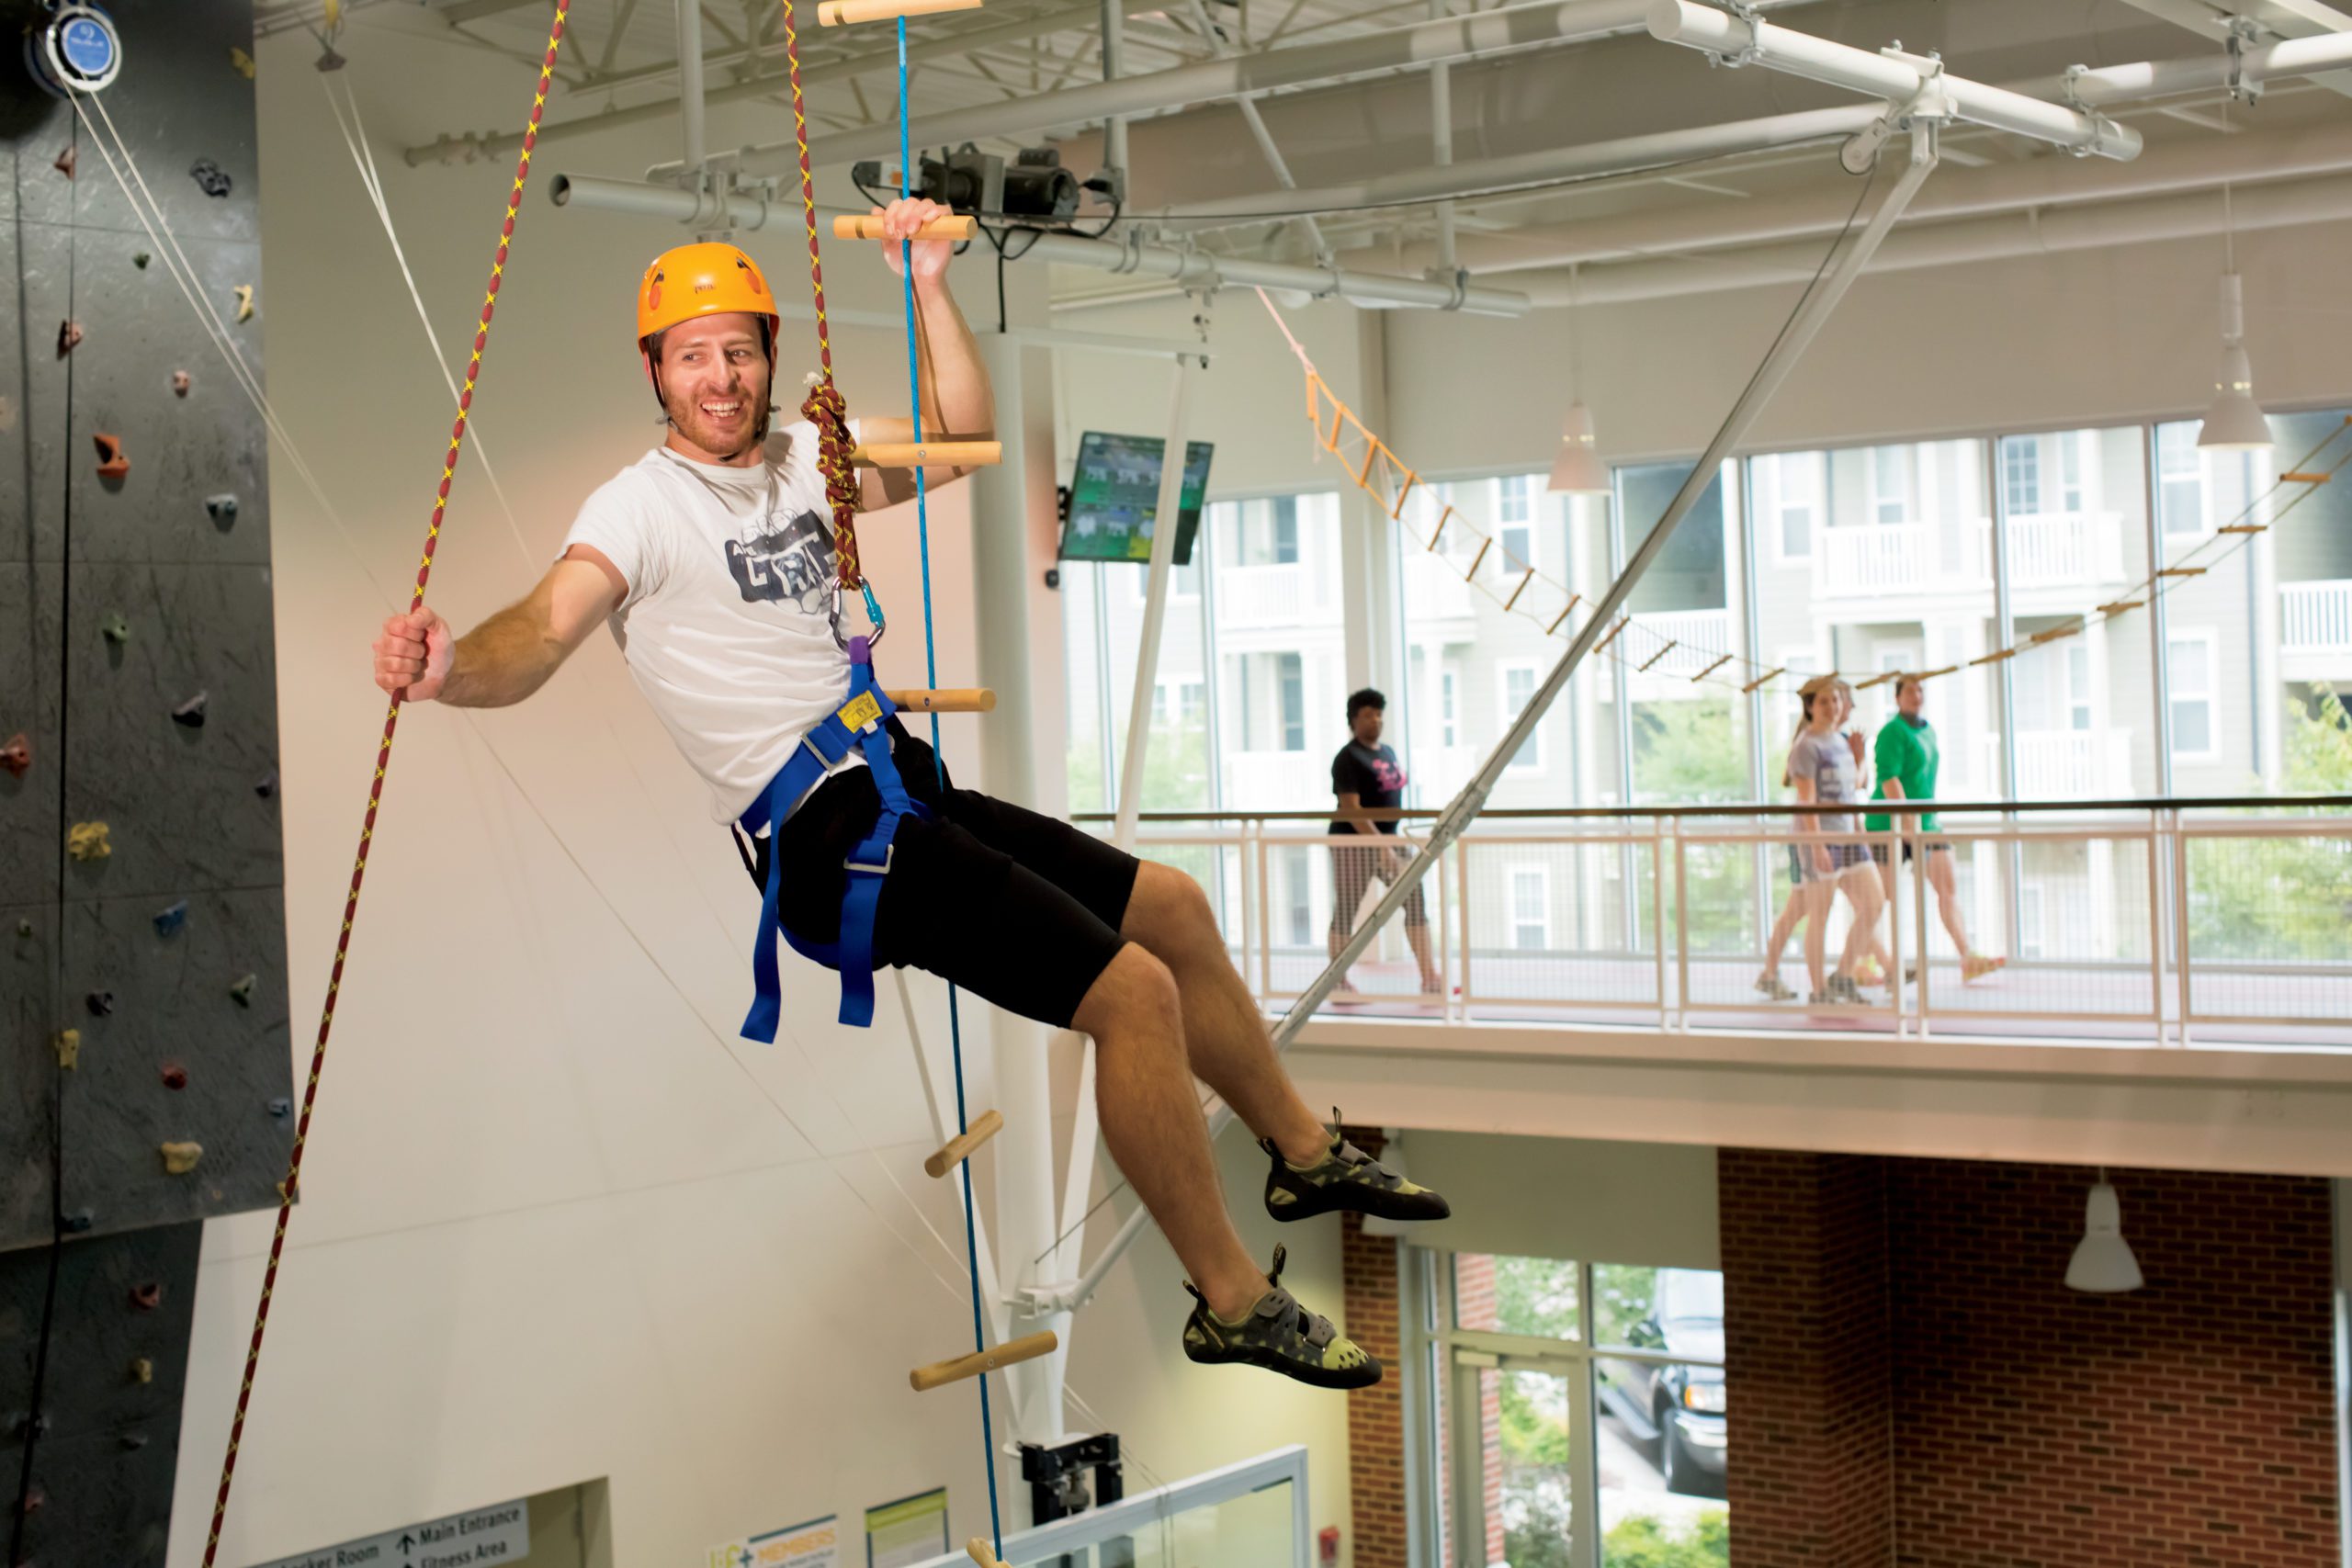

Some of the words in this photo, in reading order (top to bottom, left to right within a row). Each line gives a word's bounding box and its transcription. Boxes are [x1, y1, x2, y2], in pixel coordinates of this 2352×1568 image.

[420, 1523, 456, 1545] Main
[459, 1508, 519, 1536] Entrance
[336, 1546, 379, 1567] Room
[475, 1540, 507, 1560] Area
